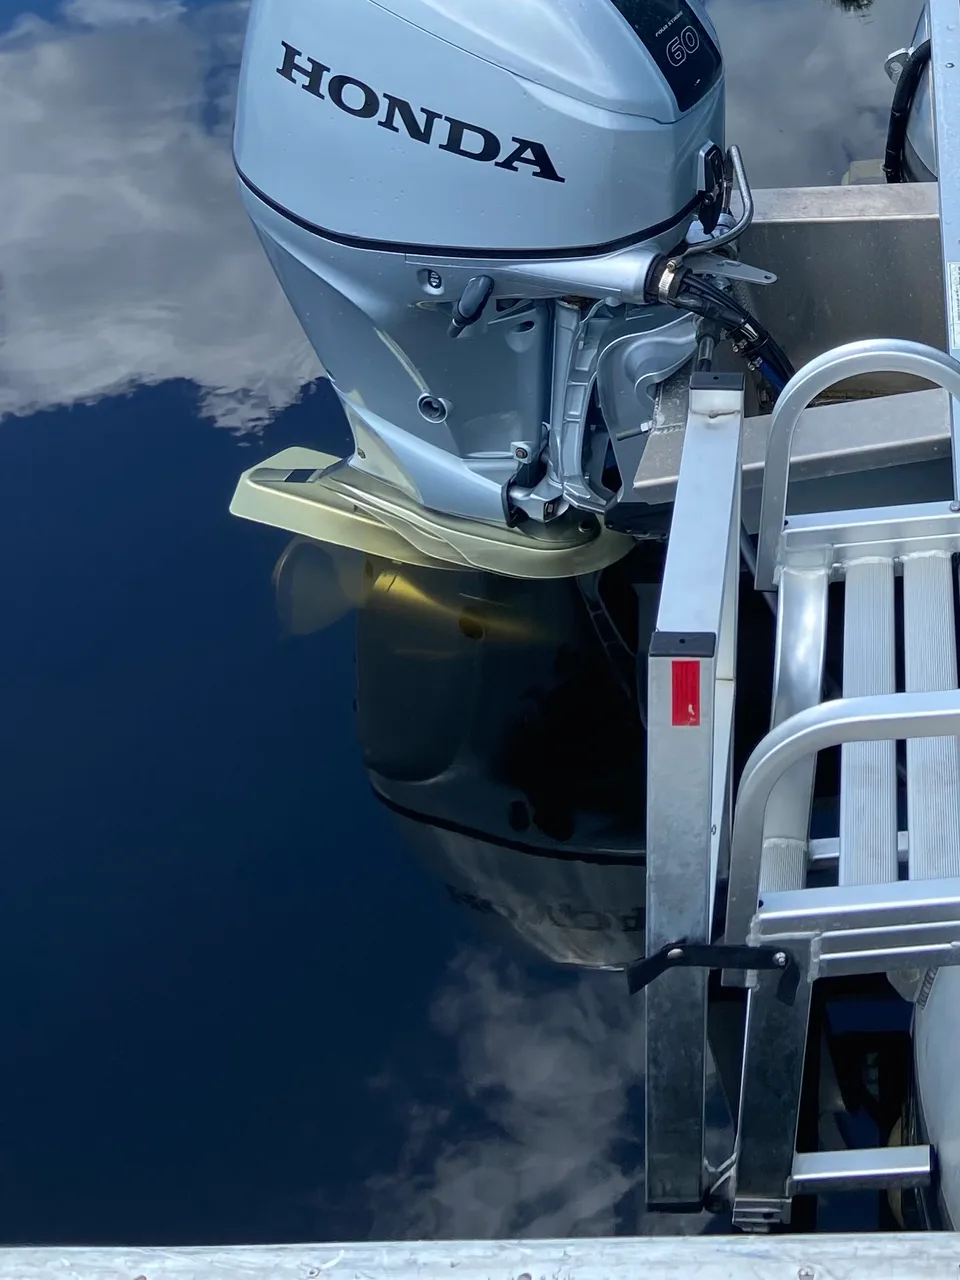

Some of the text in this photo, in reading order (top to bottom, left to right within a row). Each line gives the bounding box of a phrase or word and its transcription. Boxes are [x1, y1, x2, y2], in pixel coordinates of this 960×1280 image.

[655, 24, 668, 38] FOUR
[666, 25, 700, 67] 60
[275, 39, 566, 184] HONDA
